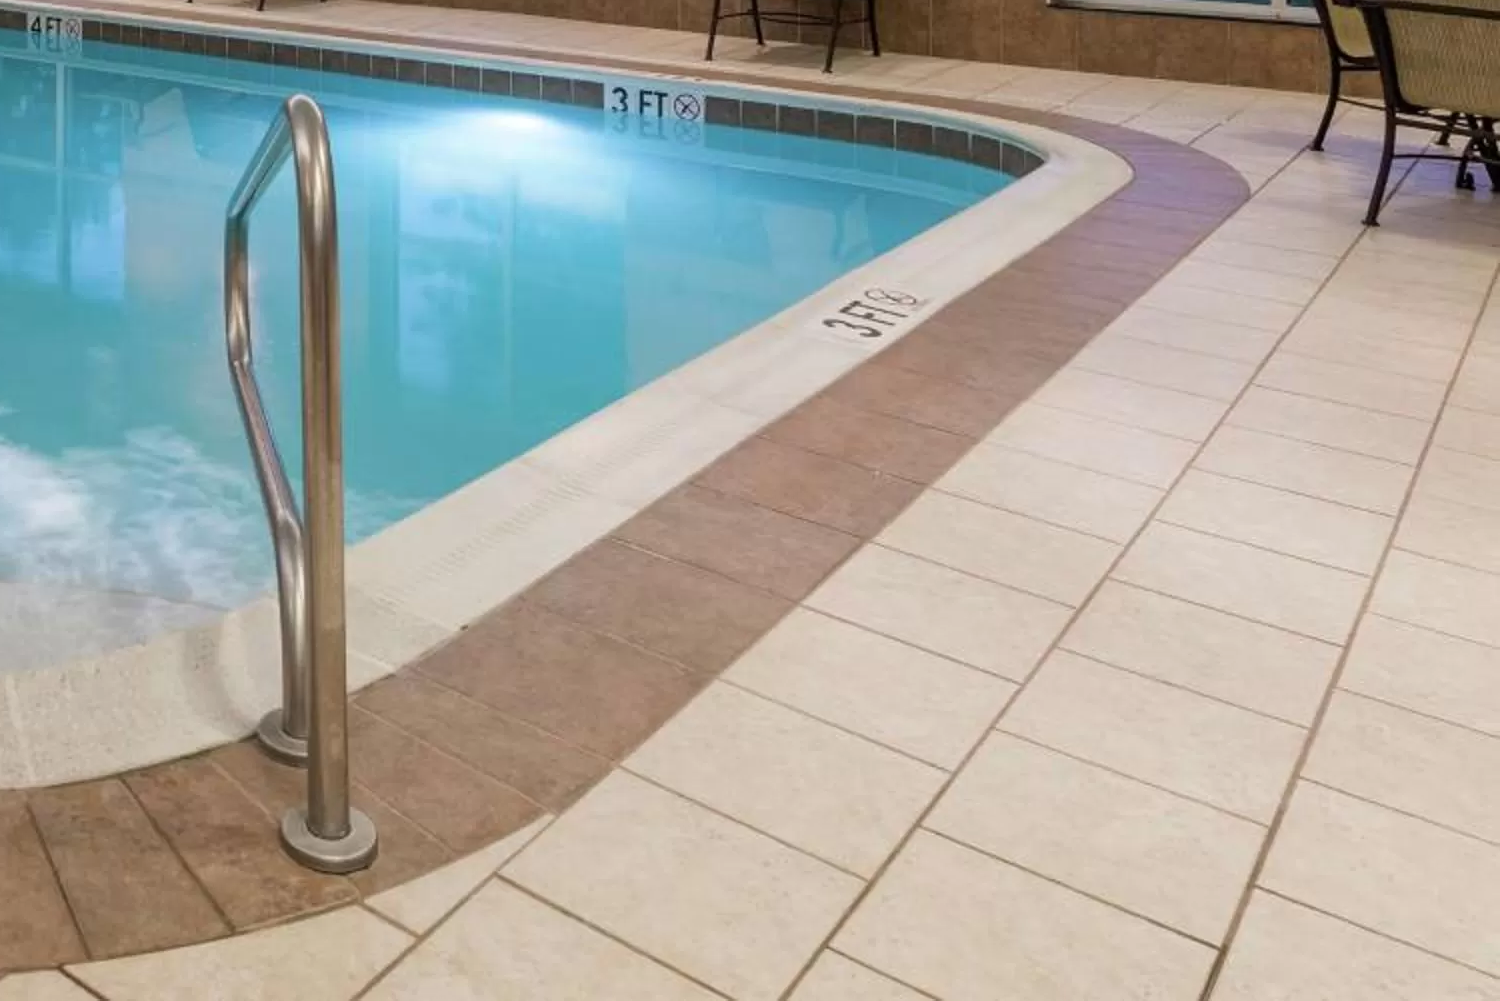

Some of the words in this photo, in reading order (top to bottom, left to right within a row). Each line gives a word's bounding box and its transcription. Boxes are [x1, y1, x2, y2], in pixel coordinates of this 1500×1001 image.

[31, 16, 42, 32] 4
[46, 16, 63, 33] FT
[611, 87, 629, 113] 3
[639, 89, 669, 117] FT
[838, 300, 908, 326] FT
[822, 319, 882, 337] 3
